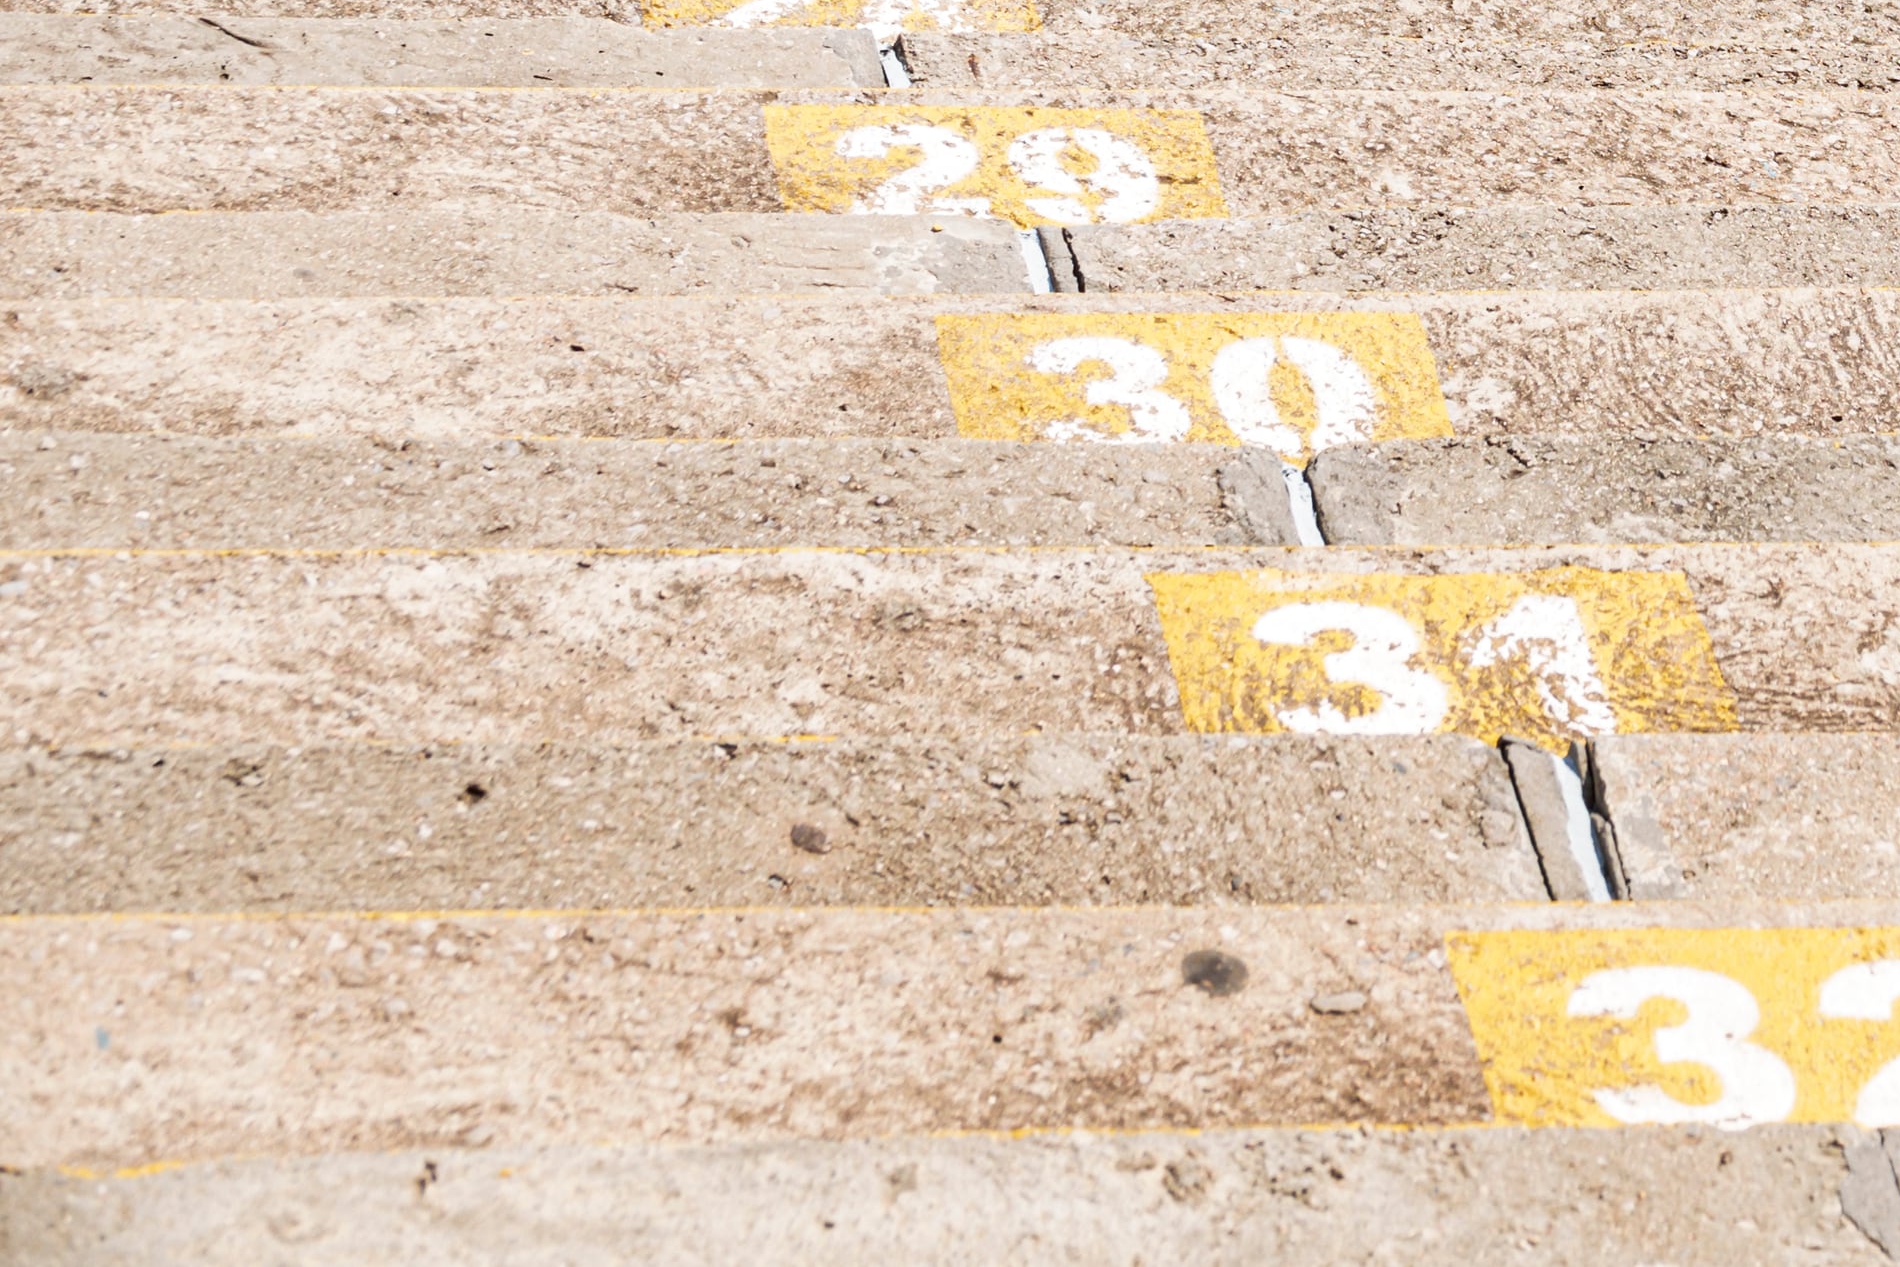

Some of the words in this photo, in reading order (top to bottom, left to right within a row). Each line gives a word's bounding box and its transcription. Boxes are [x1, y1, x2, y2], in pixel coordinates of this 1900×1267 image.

[835, 122, 1160, 226] 29
[1023, 333, 1379, 454] 30
[1251, 592, 1617, 736] 31
